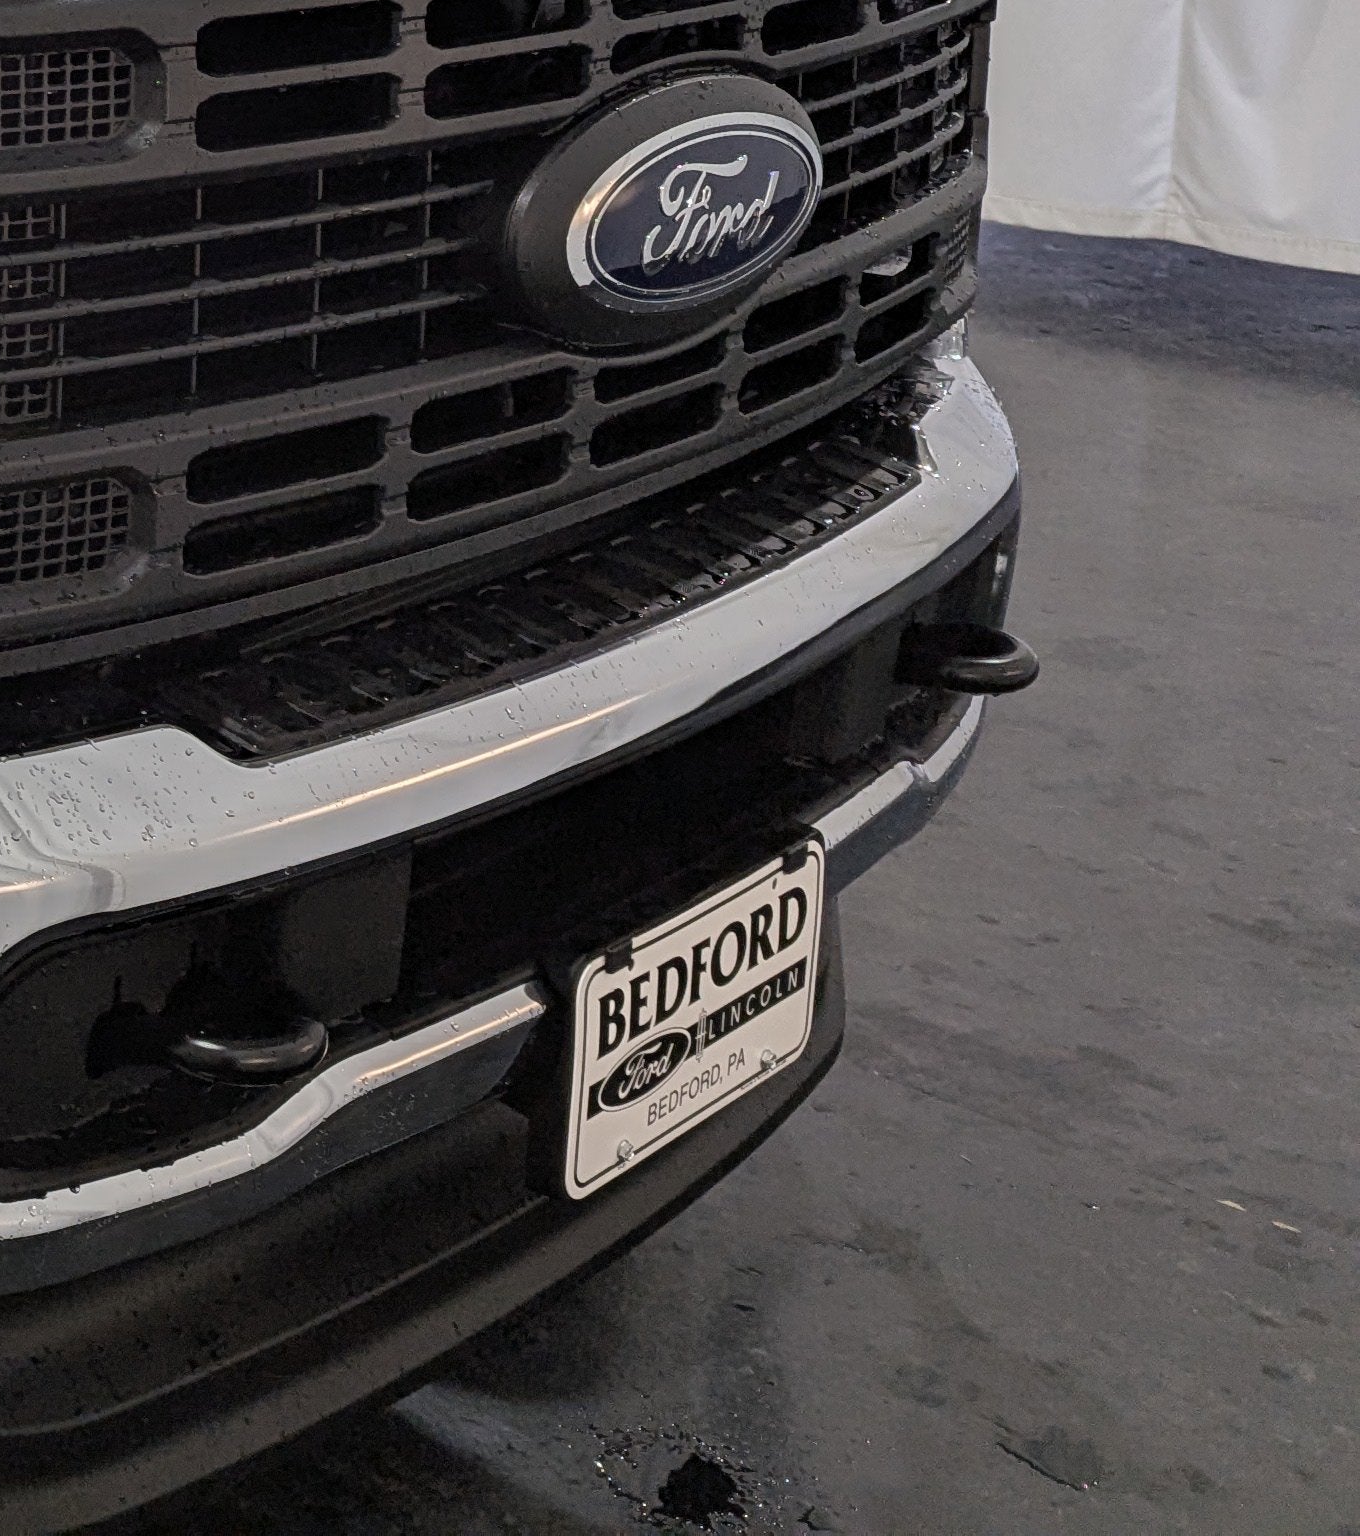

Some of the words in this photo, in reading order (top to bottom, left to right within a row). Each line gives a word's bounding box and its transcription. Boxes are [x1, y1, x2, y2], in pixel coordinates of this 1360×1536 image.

[641, 154, 780, 276] Ford
[597, 887, 807, 1059] BEDFORD
[708, 967, 799, 1040] LINCOLN
[618, 1040, 674, 1101] Ford
[647, 1064, 723, 1126] BEDFORD,
[726, 1048, 746, 1077] PA
